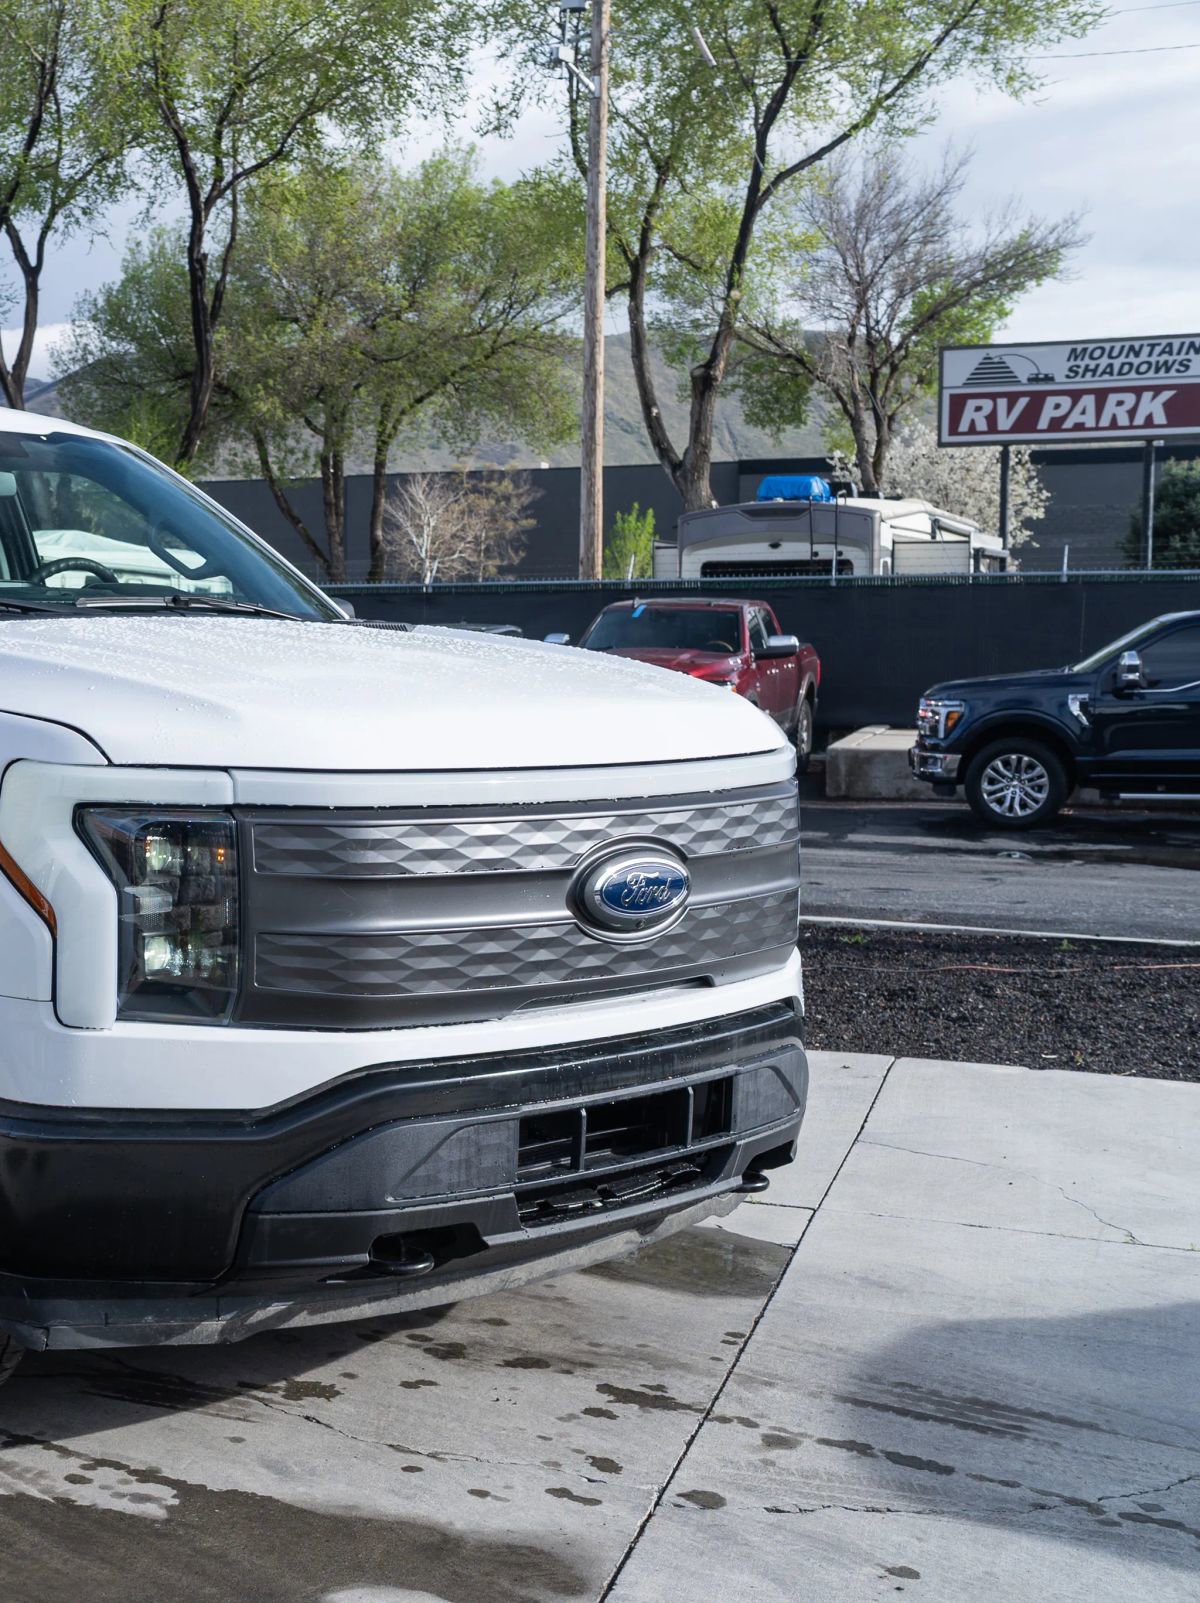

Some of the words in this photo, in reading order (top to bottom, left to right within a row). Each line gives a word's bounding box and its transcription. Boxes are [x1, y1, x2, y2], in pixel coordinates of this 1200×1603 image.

[1066, 341, 1200, 362] MOUNTAIN
[1065, 358, 1192, 379] SHADOWS
[957, 396, 1030, 432] RV
[1036, 390, 1178, 430] PARK
[621, 871, 671, 907] Ford
